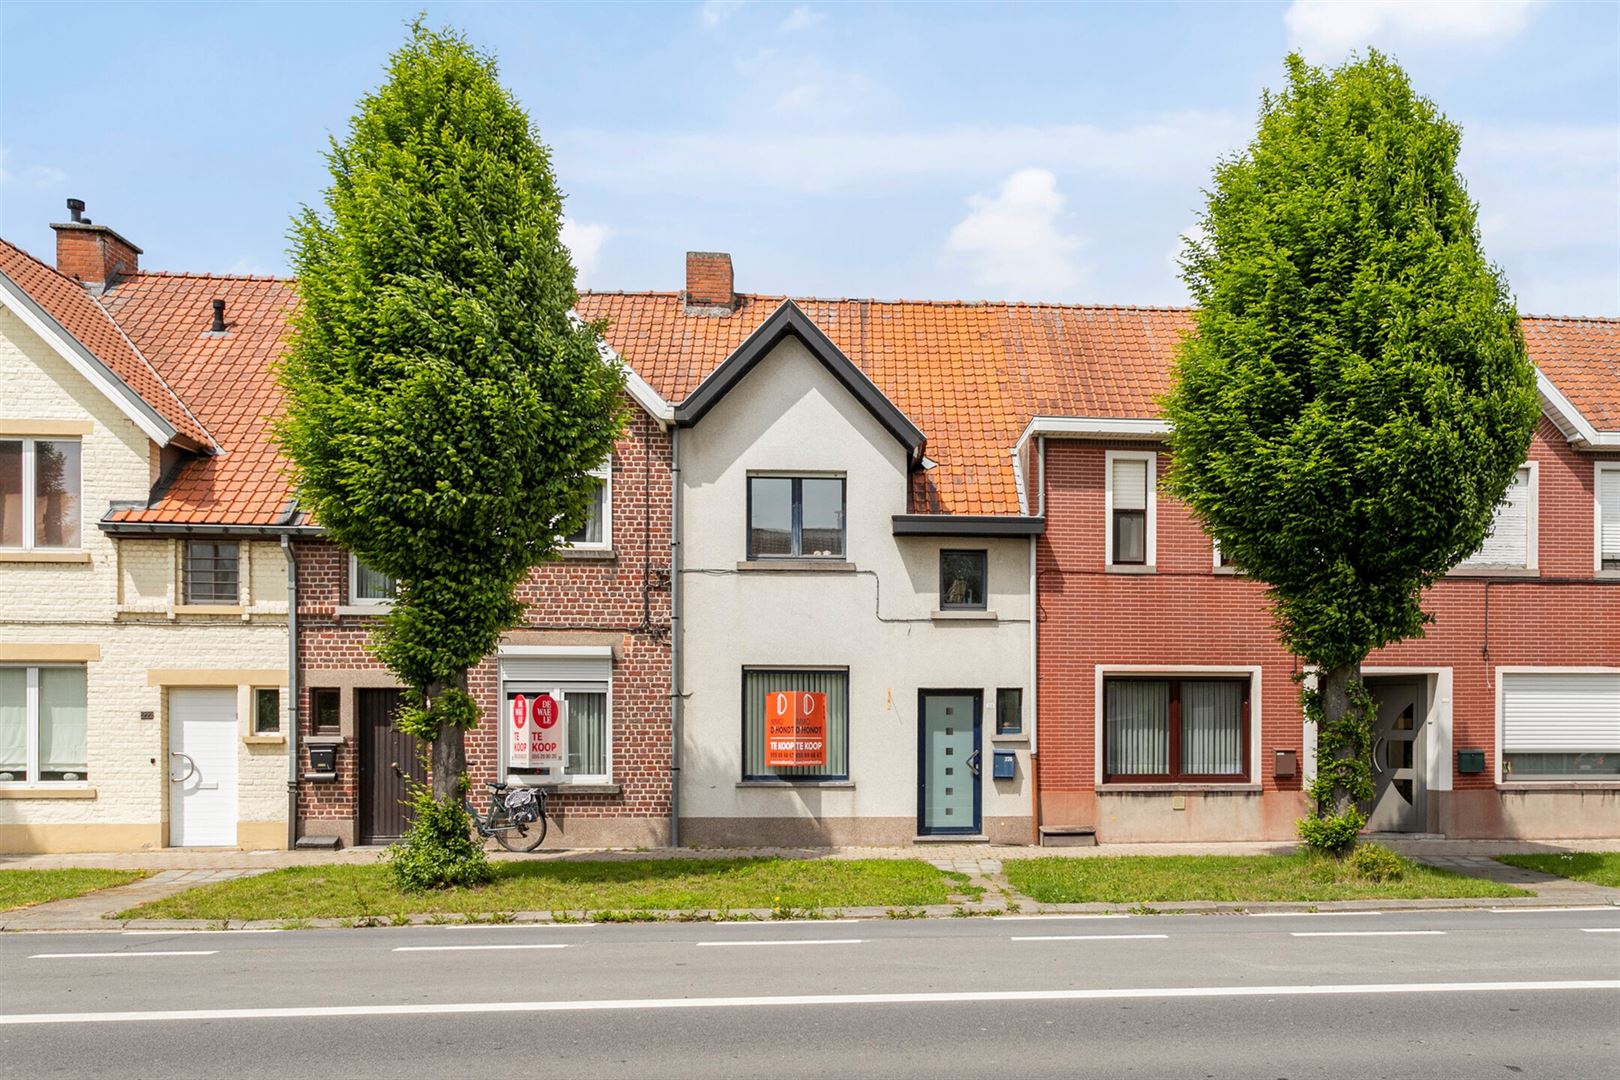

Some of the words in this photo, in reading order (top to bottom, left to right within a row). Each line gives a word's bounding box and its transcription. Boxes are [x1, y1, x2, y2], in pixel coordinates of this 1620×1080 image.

[542, 700, 551, 708] DE
[537, 708, 551, 716] WAE
[514, 732, 520, 741] TE
[531, 732, 542, 741] TE
[514, 743, 527, 752] KOOP
[531, 743, 557, 752] KOOP
[770, 742, 778, 750] TE
[778, 742, 794, 750] KOOP
[796, 742, 803, 750] TE
[804, 742, 822, 750] KOOP
